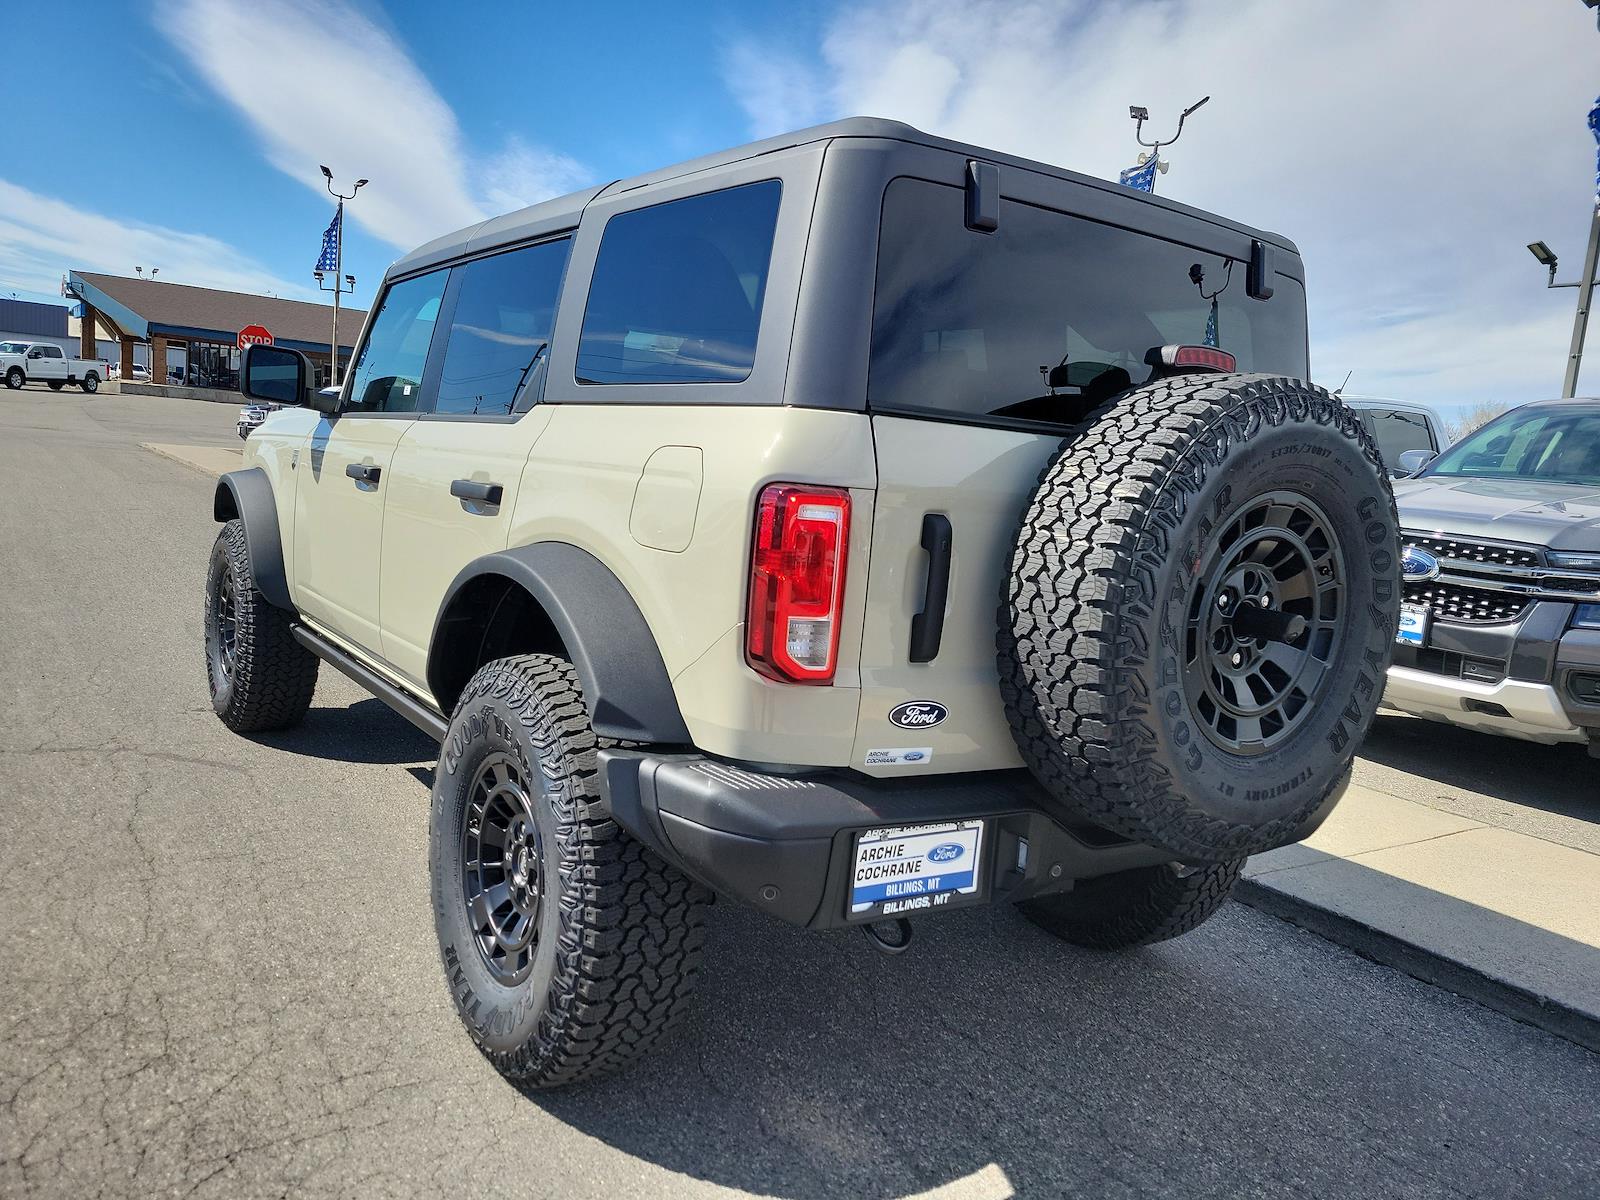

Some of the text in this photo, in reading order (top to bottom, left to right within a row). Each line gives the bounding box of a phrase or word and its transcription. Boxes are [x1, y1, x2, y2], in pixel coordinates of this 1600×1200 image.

[240, 334, 272, 347] STOP
[901, 705, 938, 724] Ford
[859, 844, 904, 862] ARCHIE
[934, 845, 958, 861] Ford
[856, 860, 922, 881] COCHRANE
[886, 878, 941, 897] BILLINGS, MT
[883, 893, 951, 914] BILLINGS, MT
